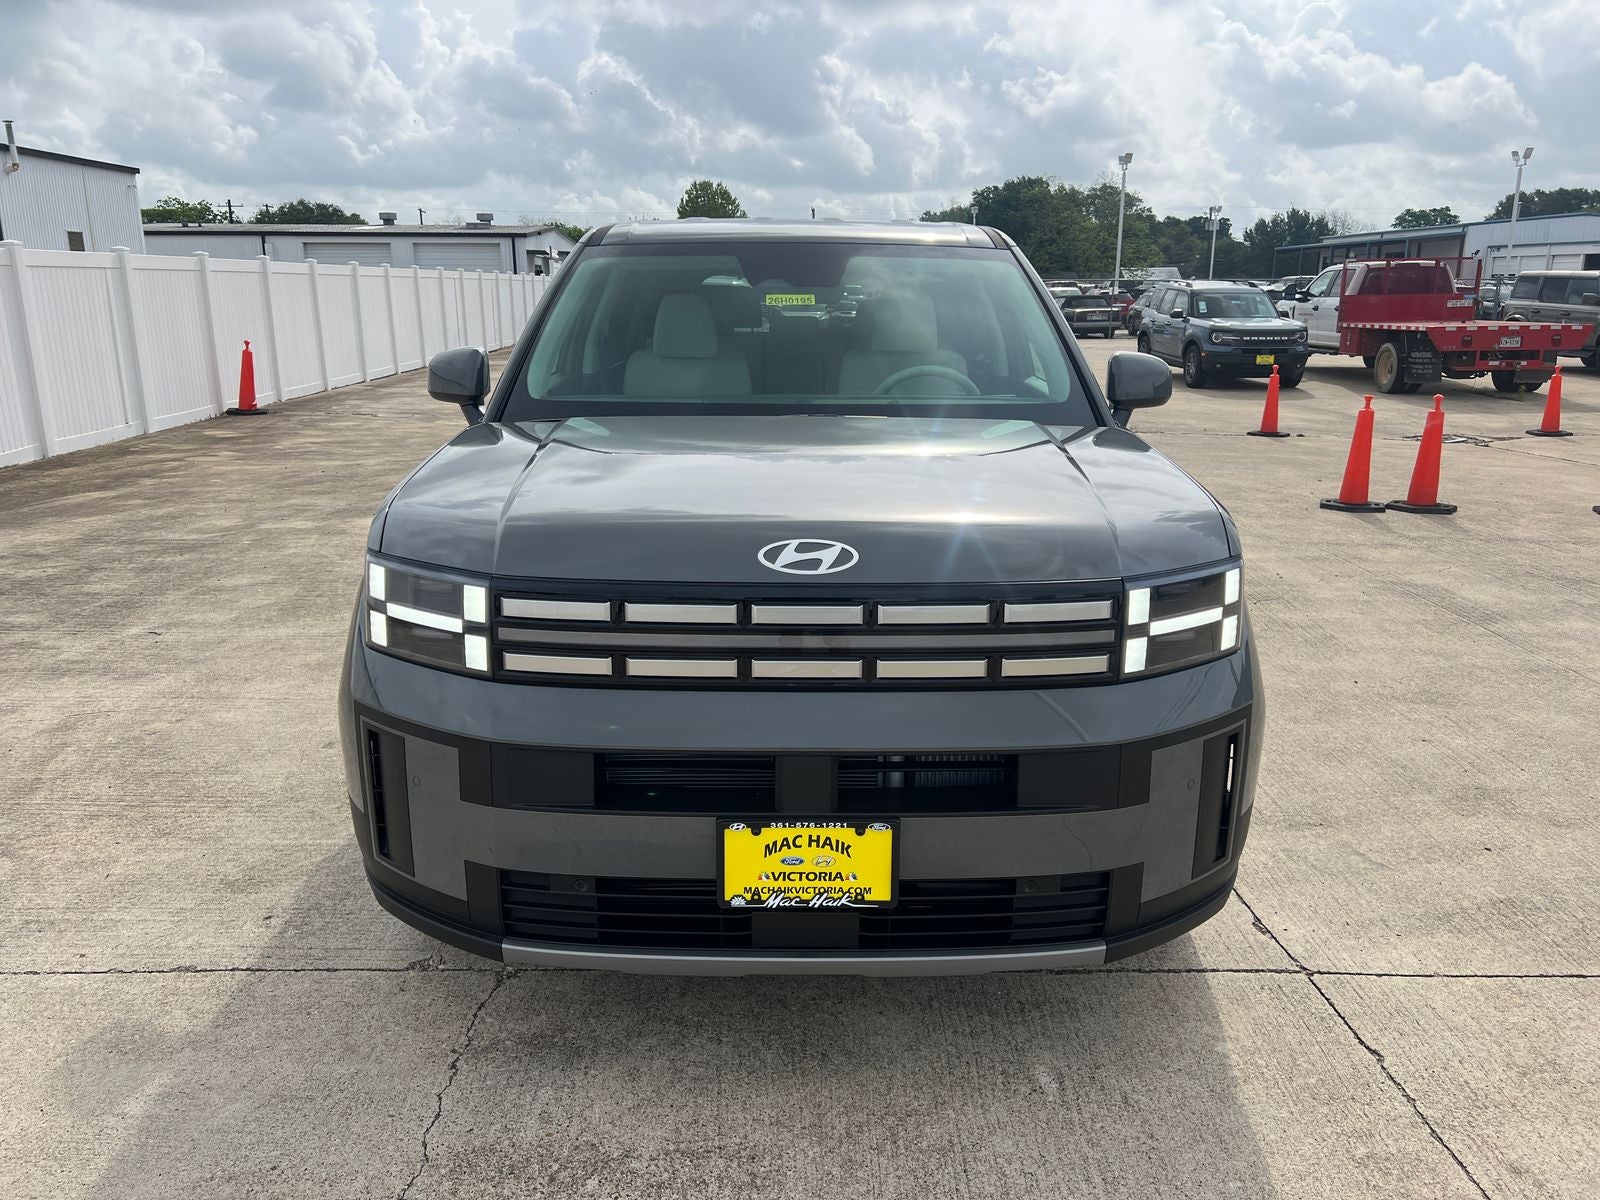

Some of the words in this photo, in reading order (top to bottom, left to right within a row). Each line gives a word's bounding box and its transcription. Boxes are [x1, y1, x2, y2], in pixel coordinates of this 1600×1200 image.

[764, 834, 803, 858] MAC
[808, 834, 852, 858] HAIK
[771, 871, 845, 882] VICTORIA
[743, 886, 872, 895] MACHAIKVICTORIA.COM
[764, 893, 808, 909] Mac
[809, 893, 854, 908] Haik
